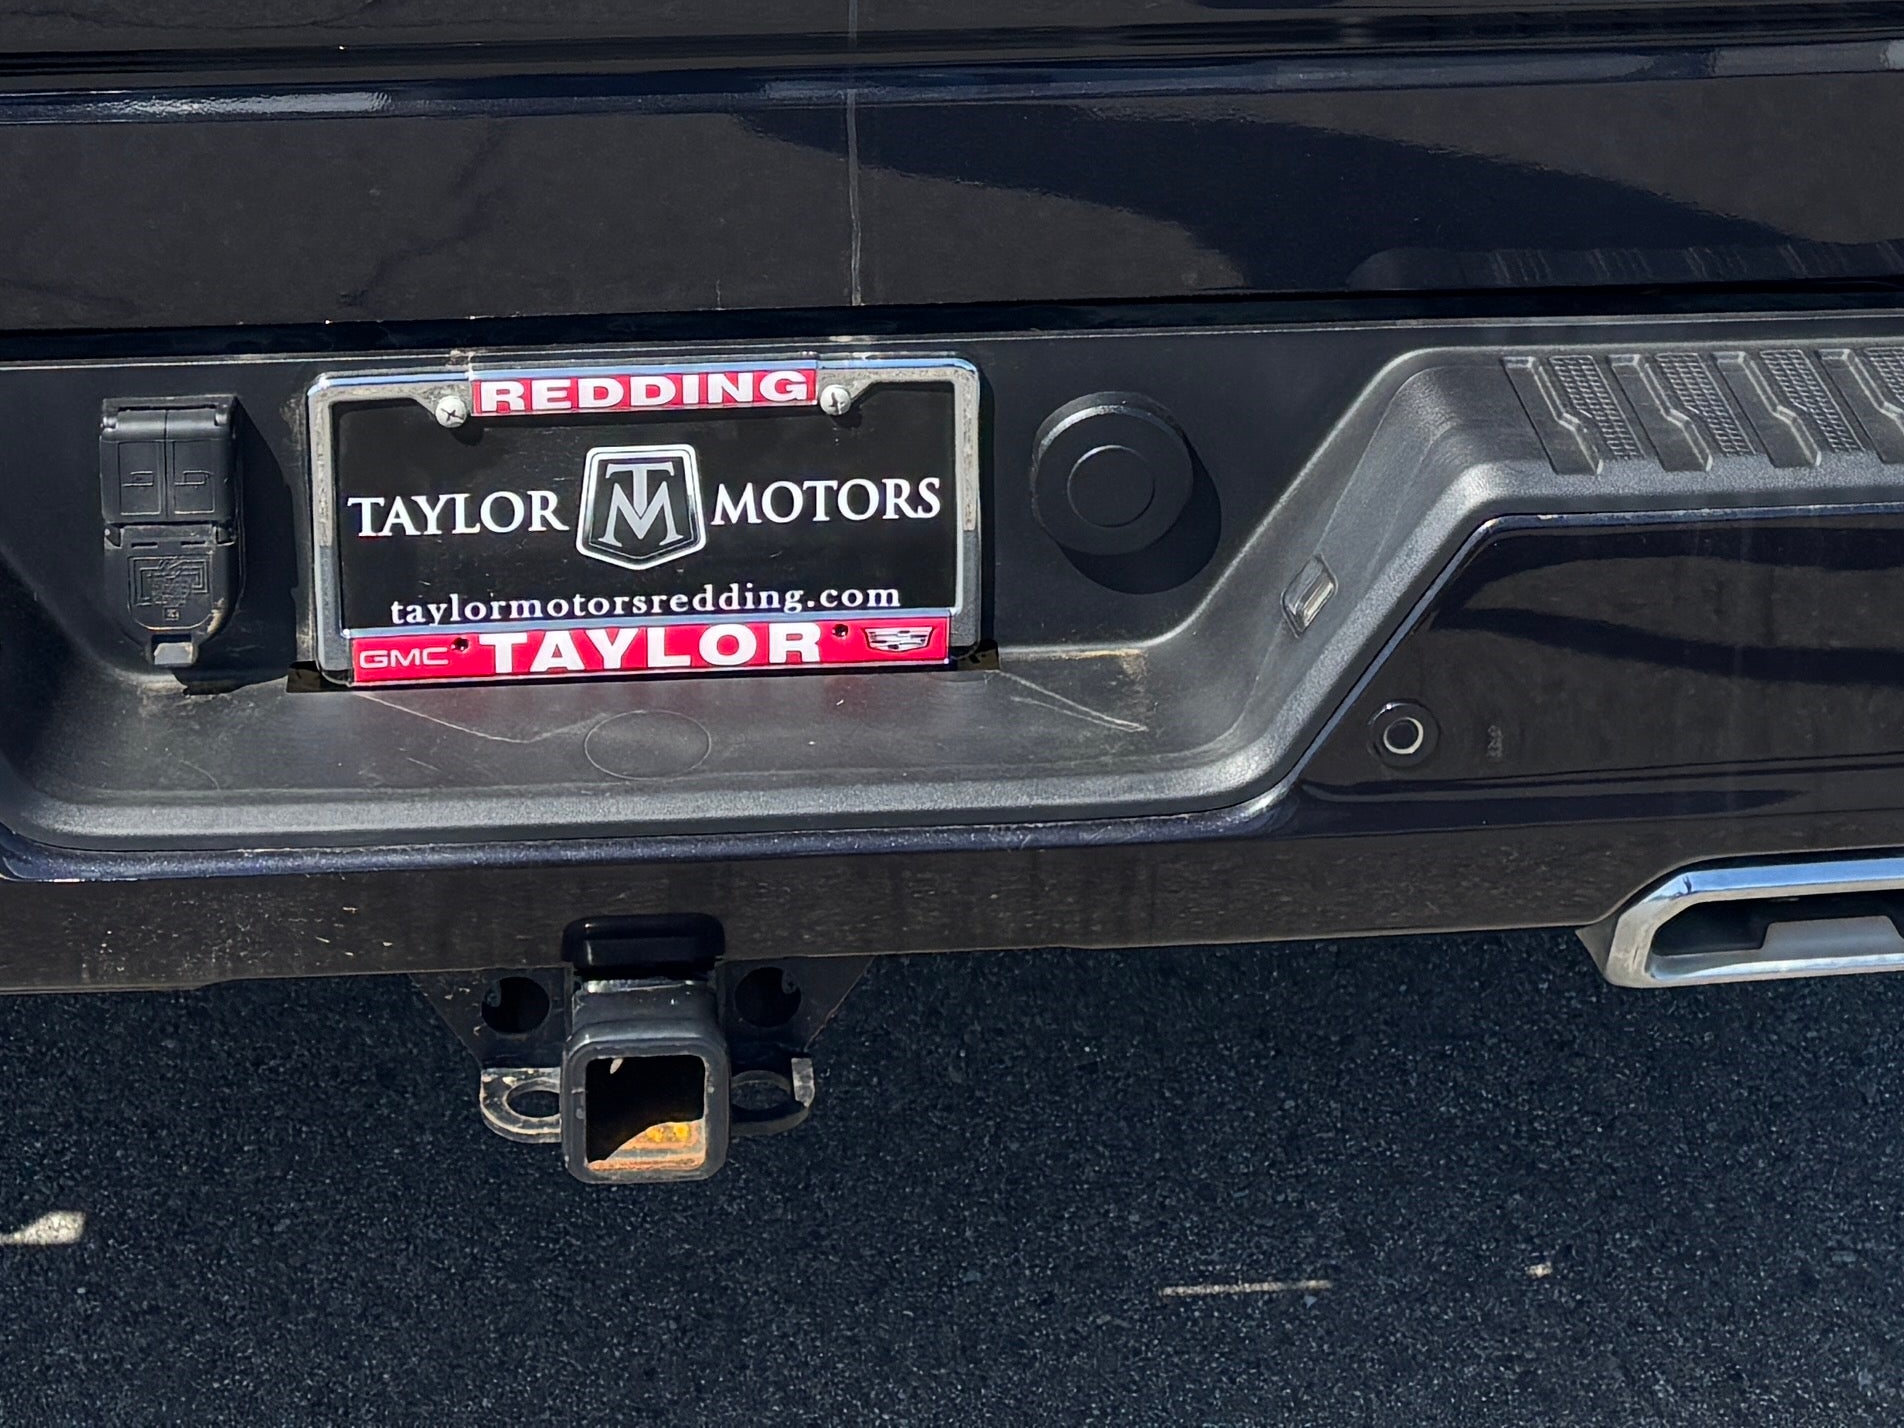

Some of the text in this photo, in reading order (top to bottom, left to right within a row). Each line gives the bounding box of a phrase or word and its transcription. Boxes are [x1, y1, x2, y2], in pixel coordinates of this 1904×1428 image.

[480, 370, 808, 413] REDDING
[346, 489, 570, 537] TAYLOR
[710, 477, 942, 526] MOTORS
[390, 582, 901, 625] taylormotorsredding.com
[359, 646, 449, 670] GMC
[478, 621, 822, 674] TAYLOR
